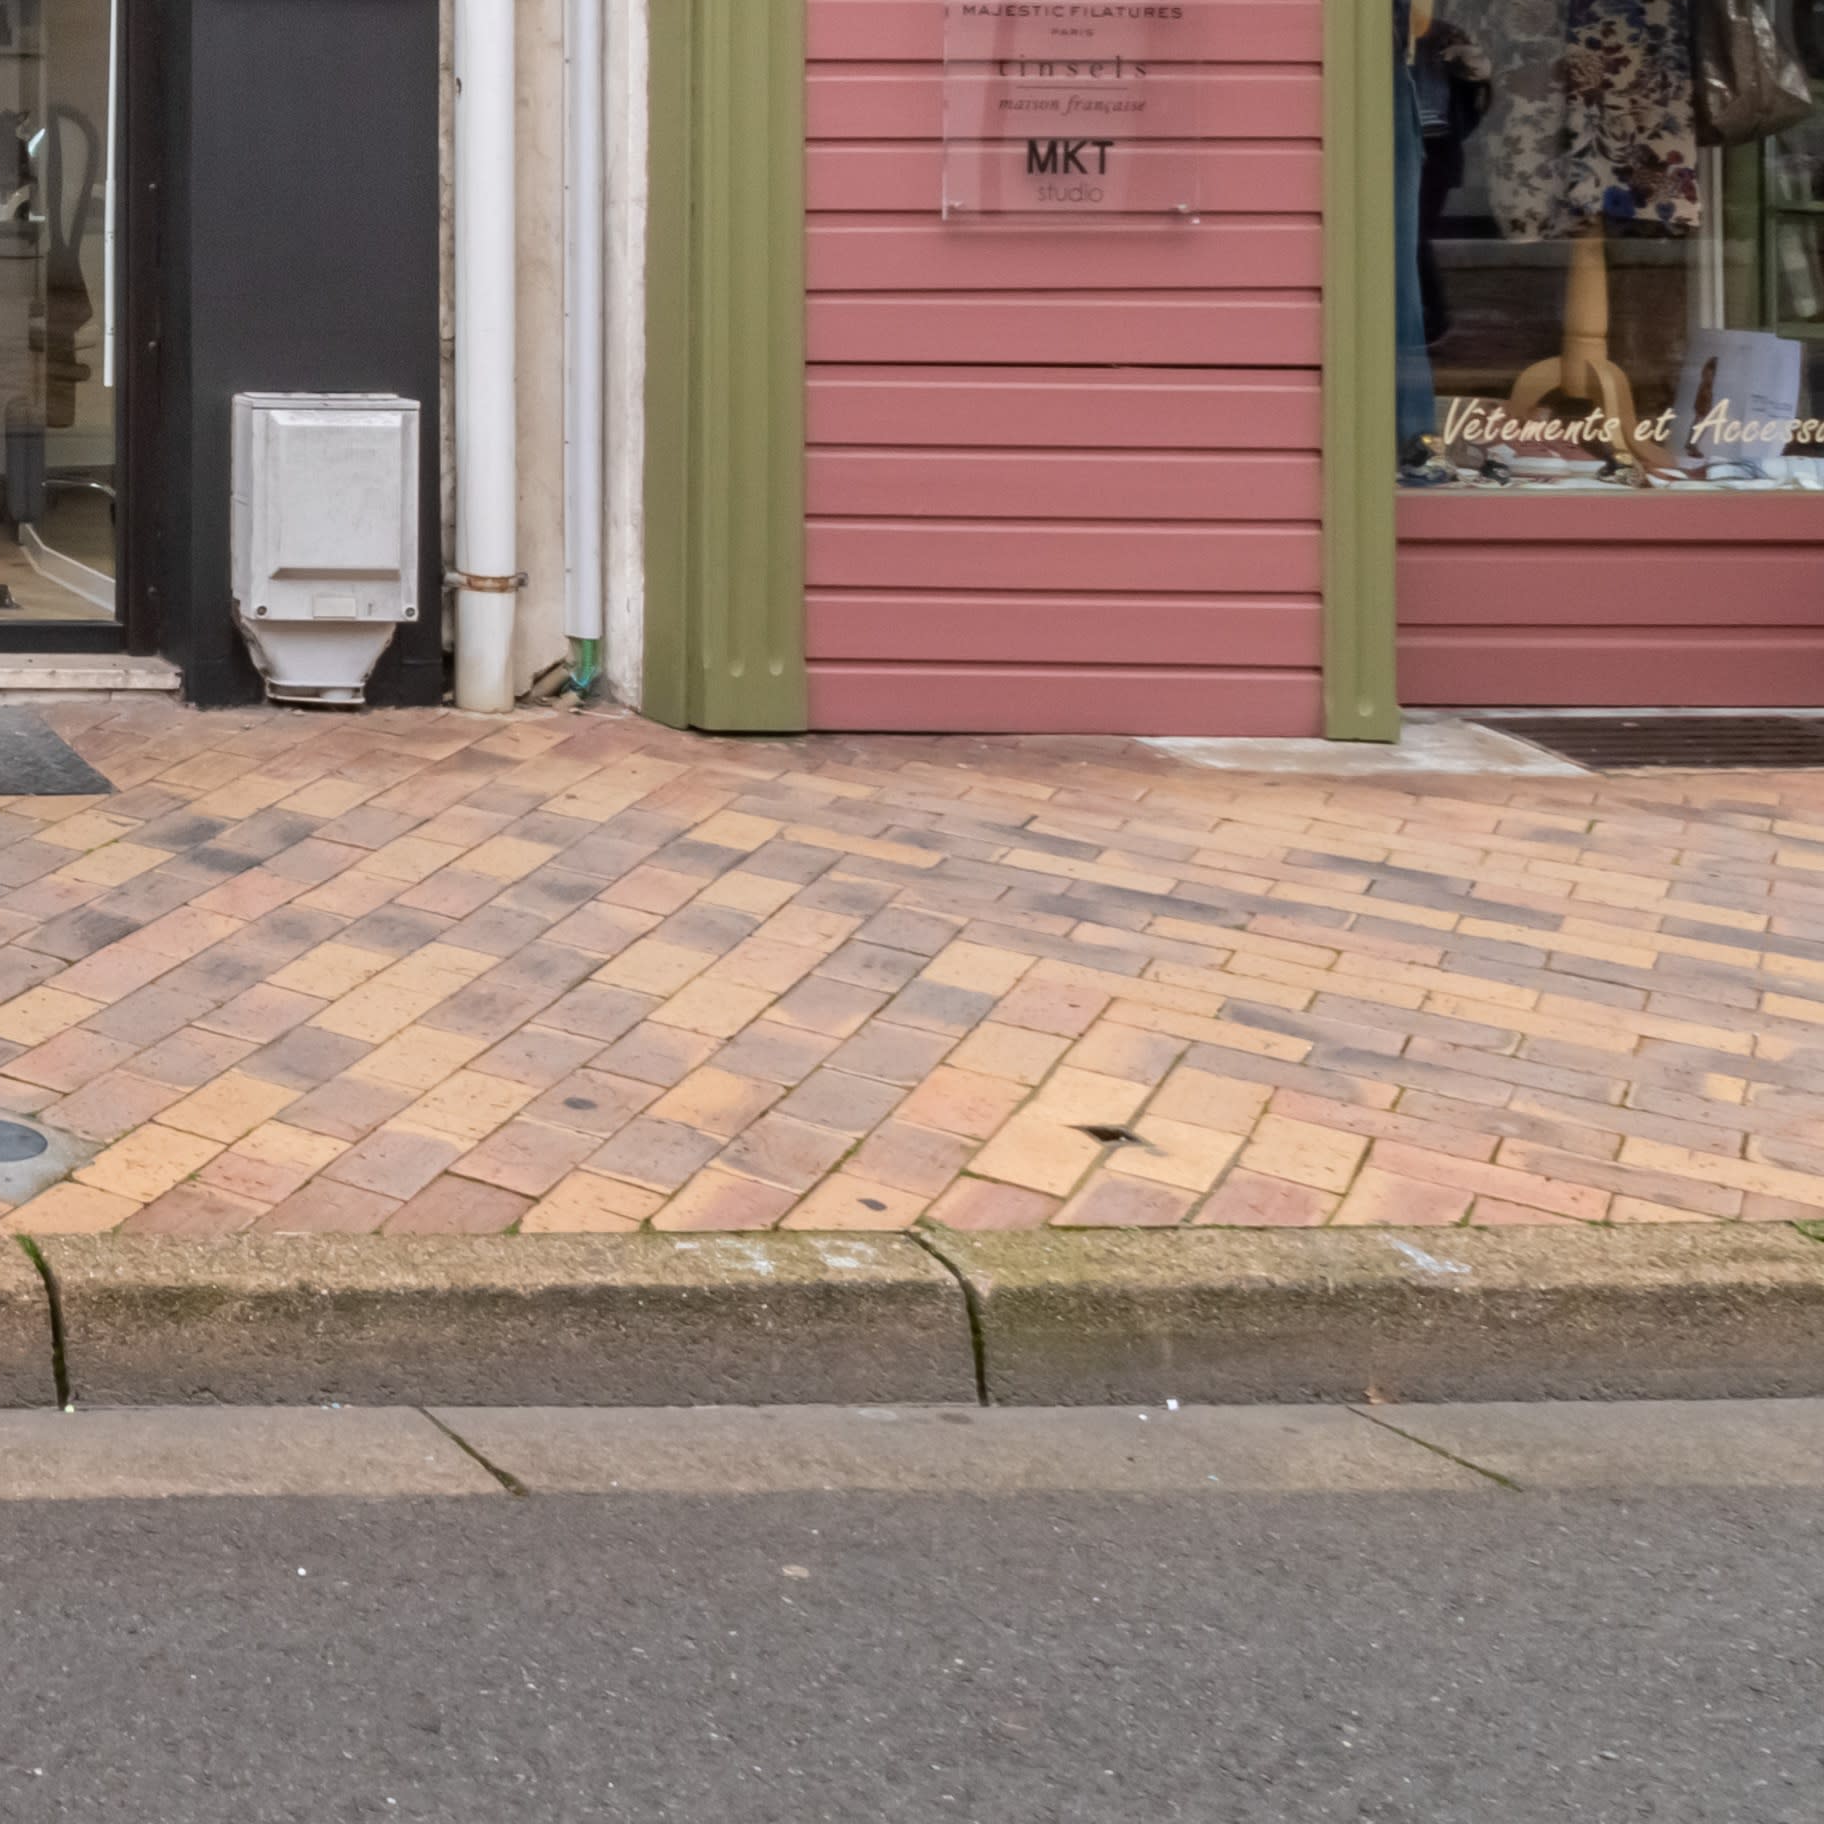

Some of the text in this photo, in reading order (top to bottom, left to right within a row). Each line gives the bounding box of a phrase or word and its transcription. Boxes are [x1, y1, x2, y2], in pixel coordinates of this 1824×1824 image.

[962, 4, 1184, 20] MAJESTIC FILATURES
[1051, 28, 1095, 37] PARIS
[998, 54, 1147, 79] tinsels
[998, 94, 1146, 117] maison française
[1026, 138, 1115, 175] MKT
[1037, 183, 1104, 203] studio
[1443, 397, 1621, 445] Vêtements
[1633, 407, 1677, 443] et
